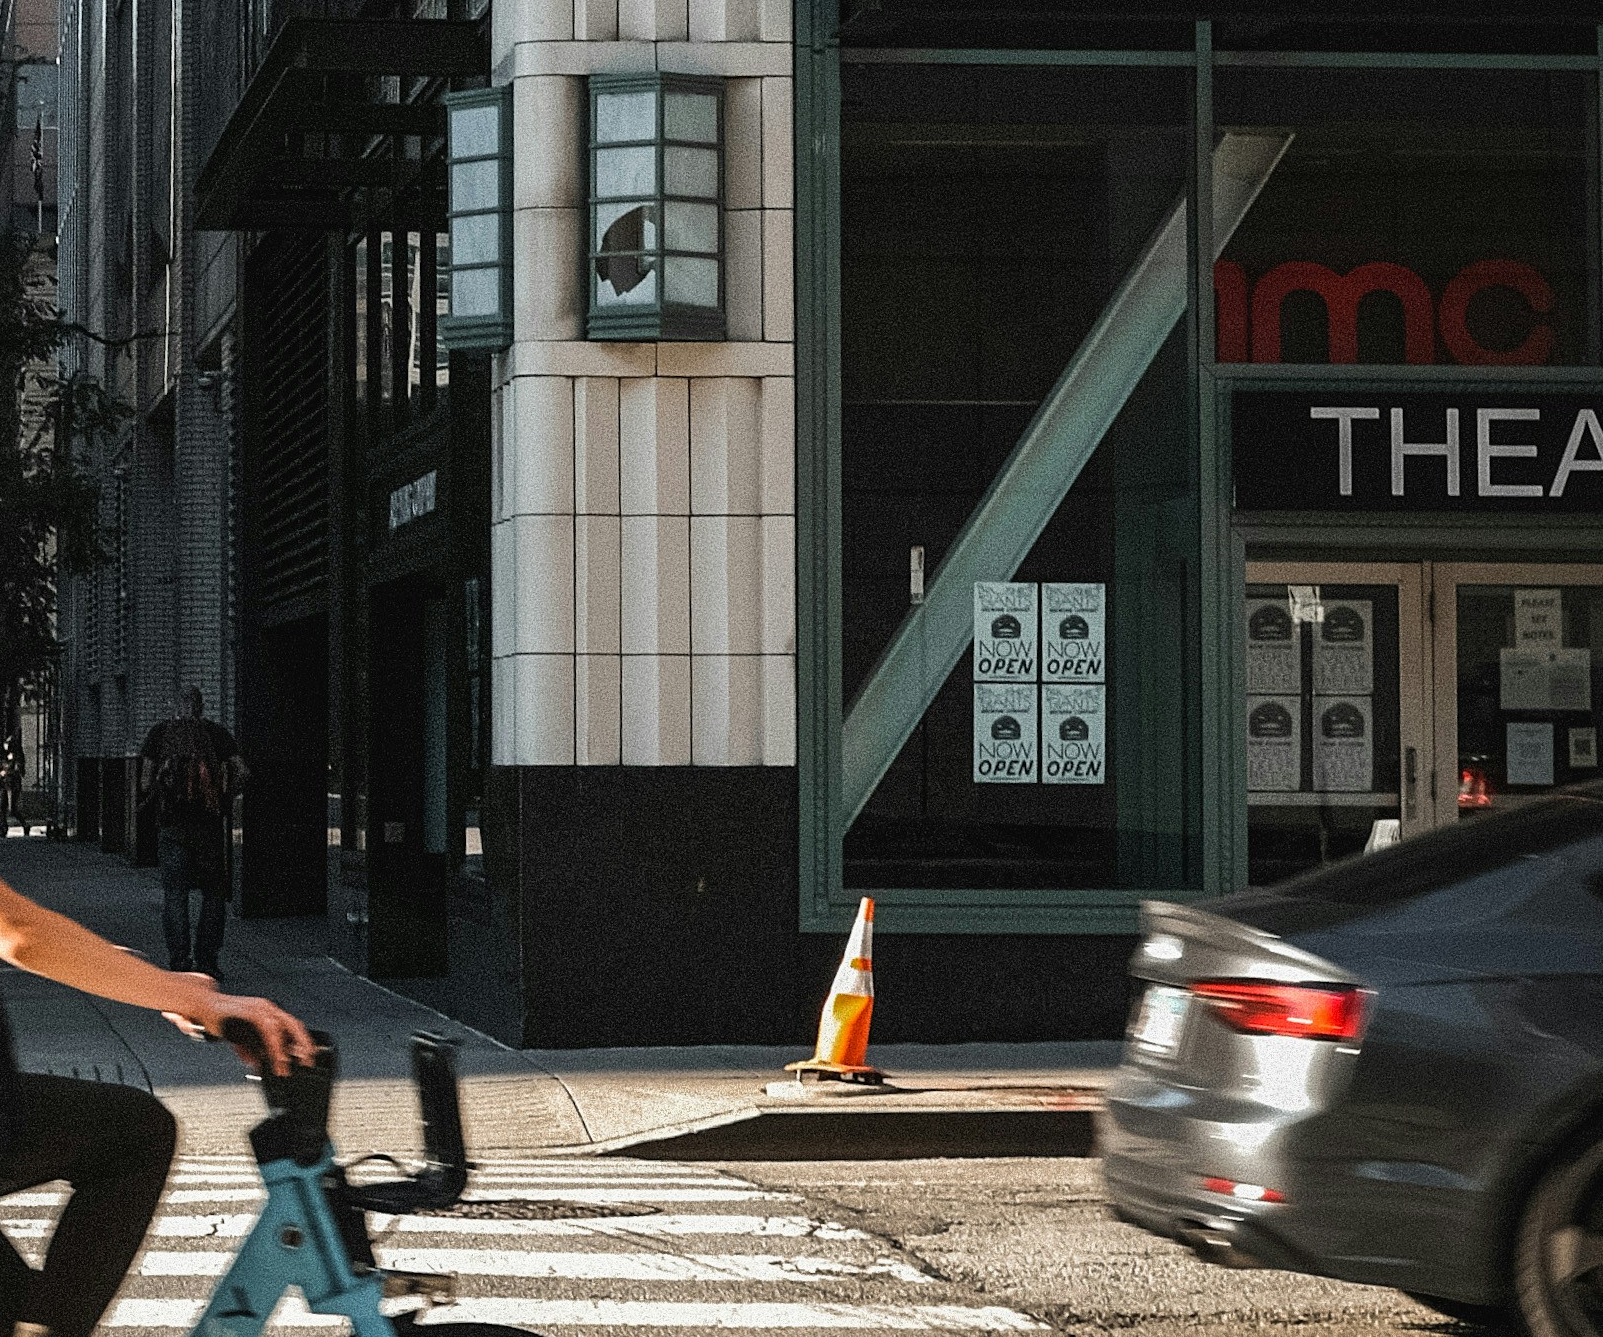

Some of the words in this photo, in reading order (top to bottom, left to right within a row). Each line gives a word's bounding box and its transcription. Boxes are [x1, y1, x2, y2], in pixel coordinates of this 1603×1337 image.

[1310, 407, 1603, 497] THEA
[979, 639, 1032, 658] NOW
[1047, 640, 1101, 659] NOW
[978, 658, 1033, 675] OPEN
[1047, 658, 1102, 676] OPEN
[979, 741, 1032, 759] NOW
[1047, 742, 1101, 760] NOW
[978, 759, 1034, 776] OPEN
[1047, 760, 1102, 777] OPEN
